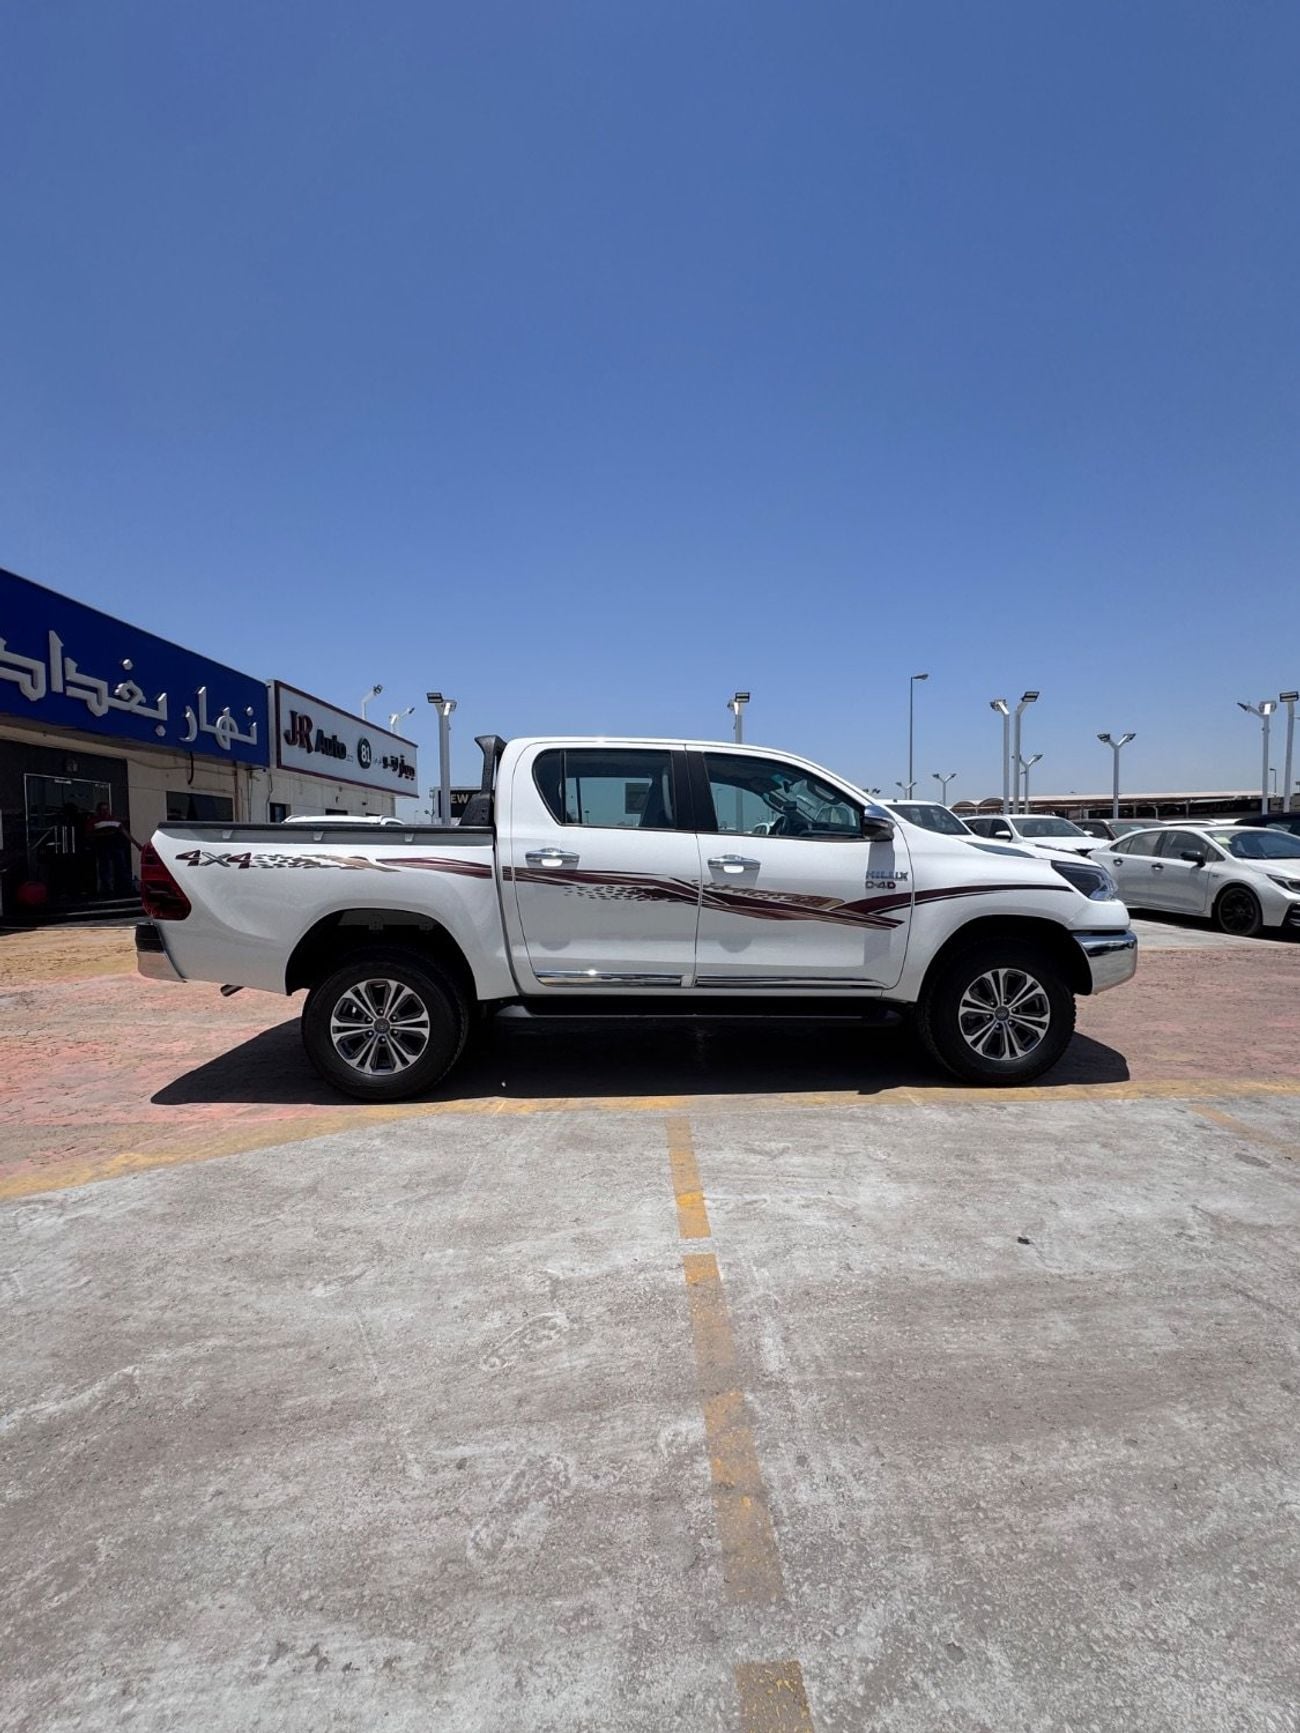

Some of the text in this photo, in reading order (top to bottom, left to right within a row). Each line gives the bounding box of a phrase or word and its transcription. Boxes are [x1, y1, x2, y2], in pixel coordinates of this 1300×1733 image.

[178, 686, 258, 751] نهار
[283, 710, 347, 760] JR Auto
[361, 744, 371, 764] 81
[865, 871, 909, 881] HILUX
[865, 881, 896, 889] D-4D
